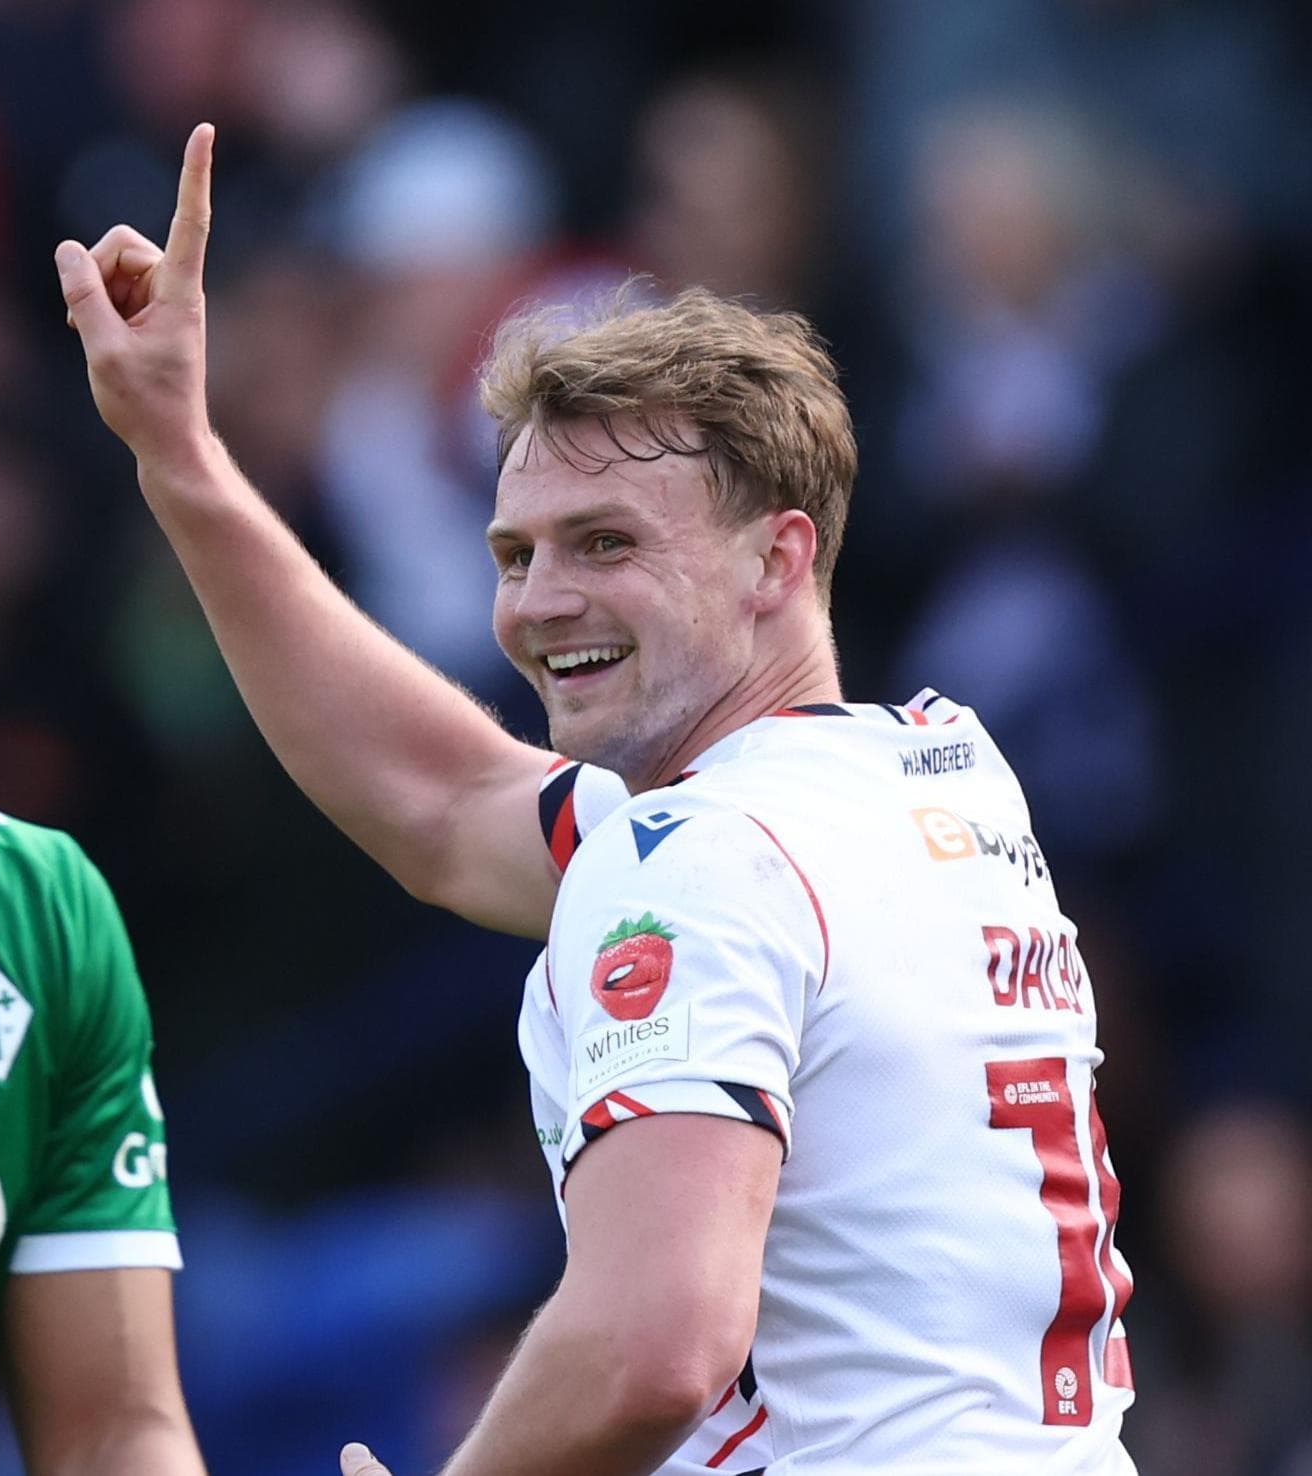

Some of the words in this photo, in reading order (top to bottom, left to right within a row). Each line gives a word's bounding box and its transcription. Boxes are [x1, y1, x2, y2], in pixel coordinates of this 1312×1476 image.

[898, 742, 976, 777] WANDERERS
[586, 1016, 670, 1064] whites
[1019, 1091, 1060, 1105] COMMUNITY
[1058, 1400, 1078, 1415] EFL
